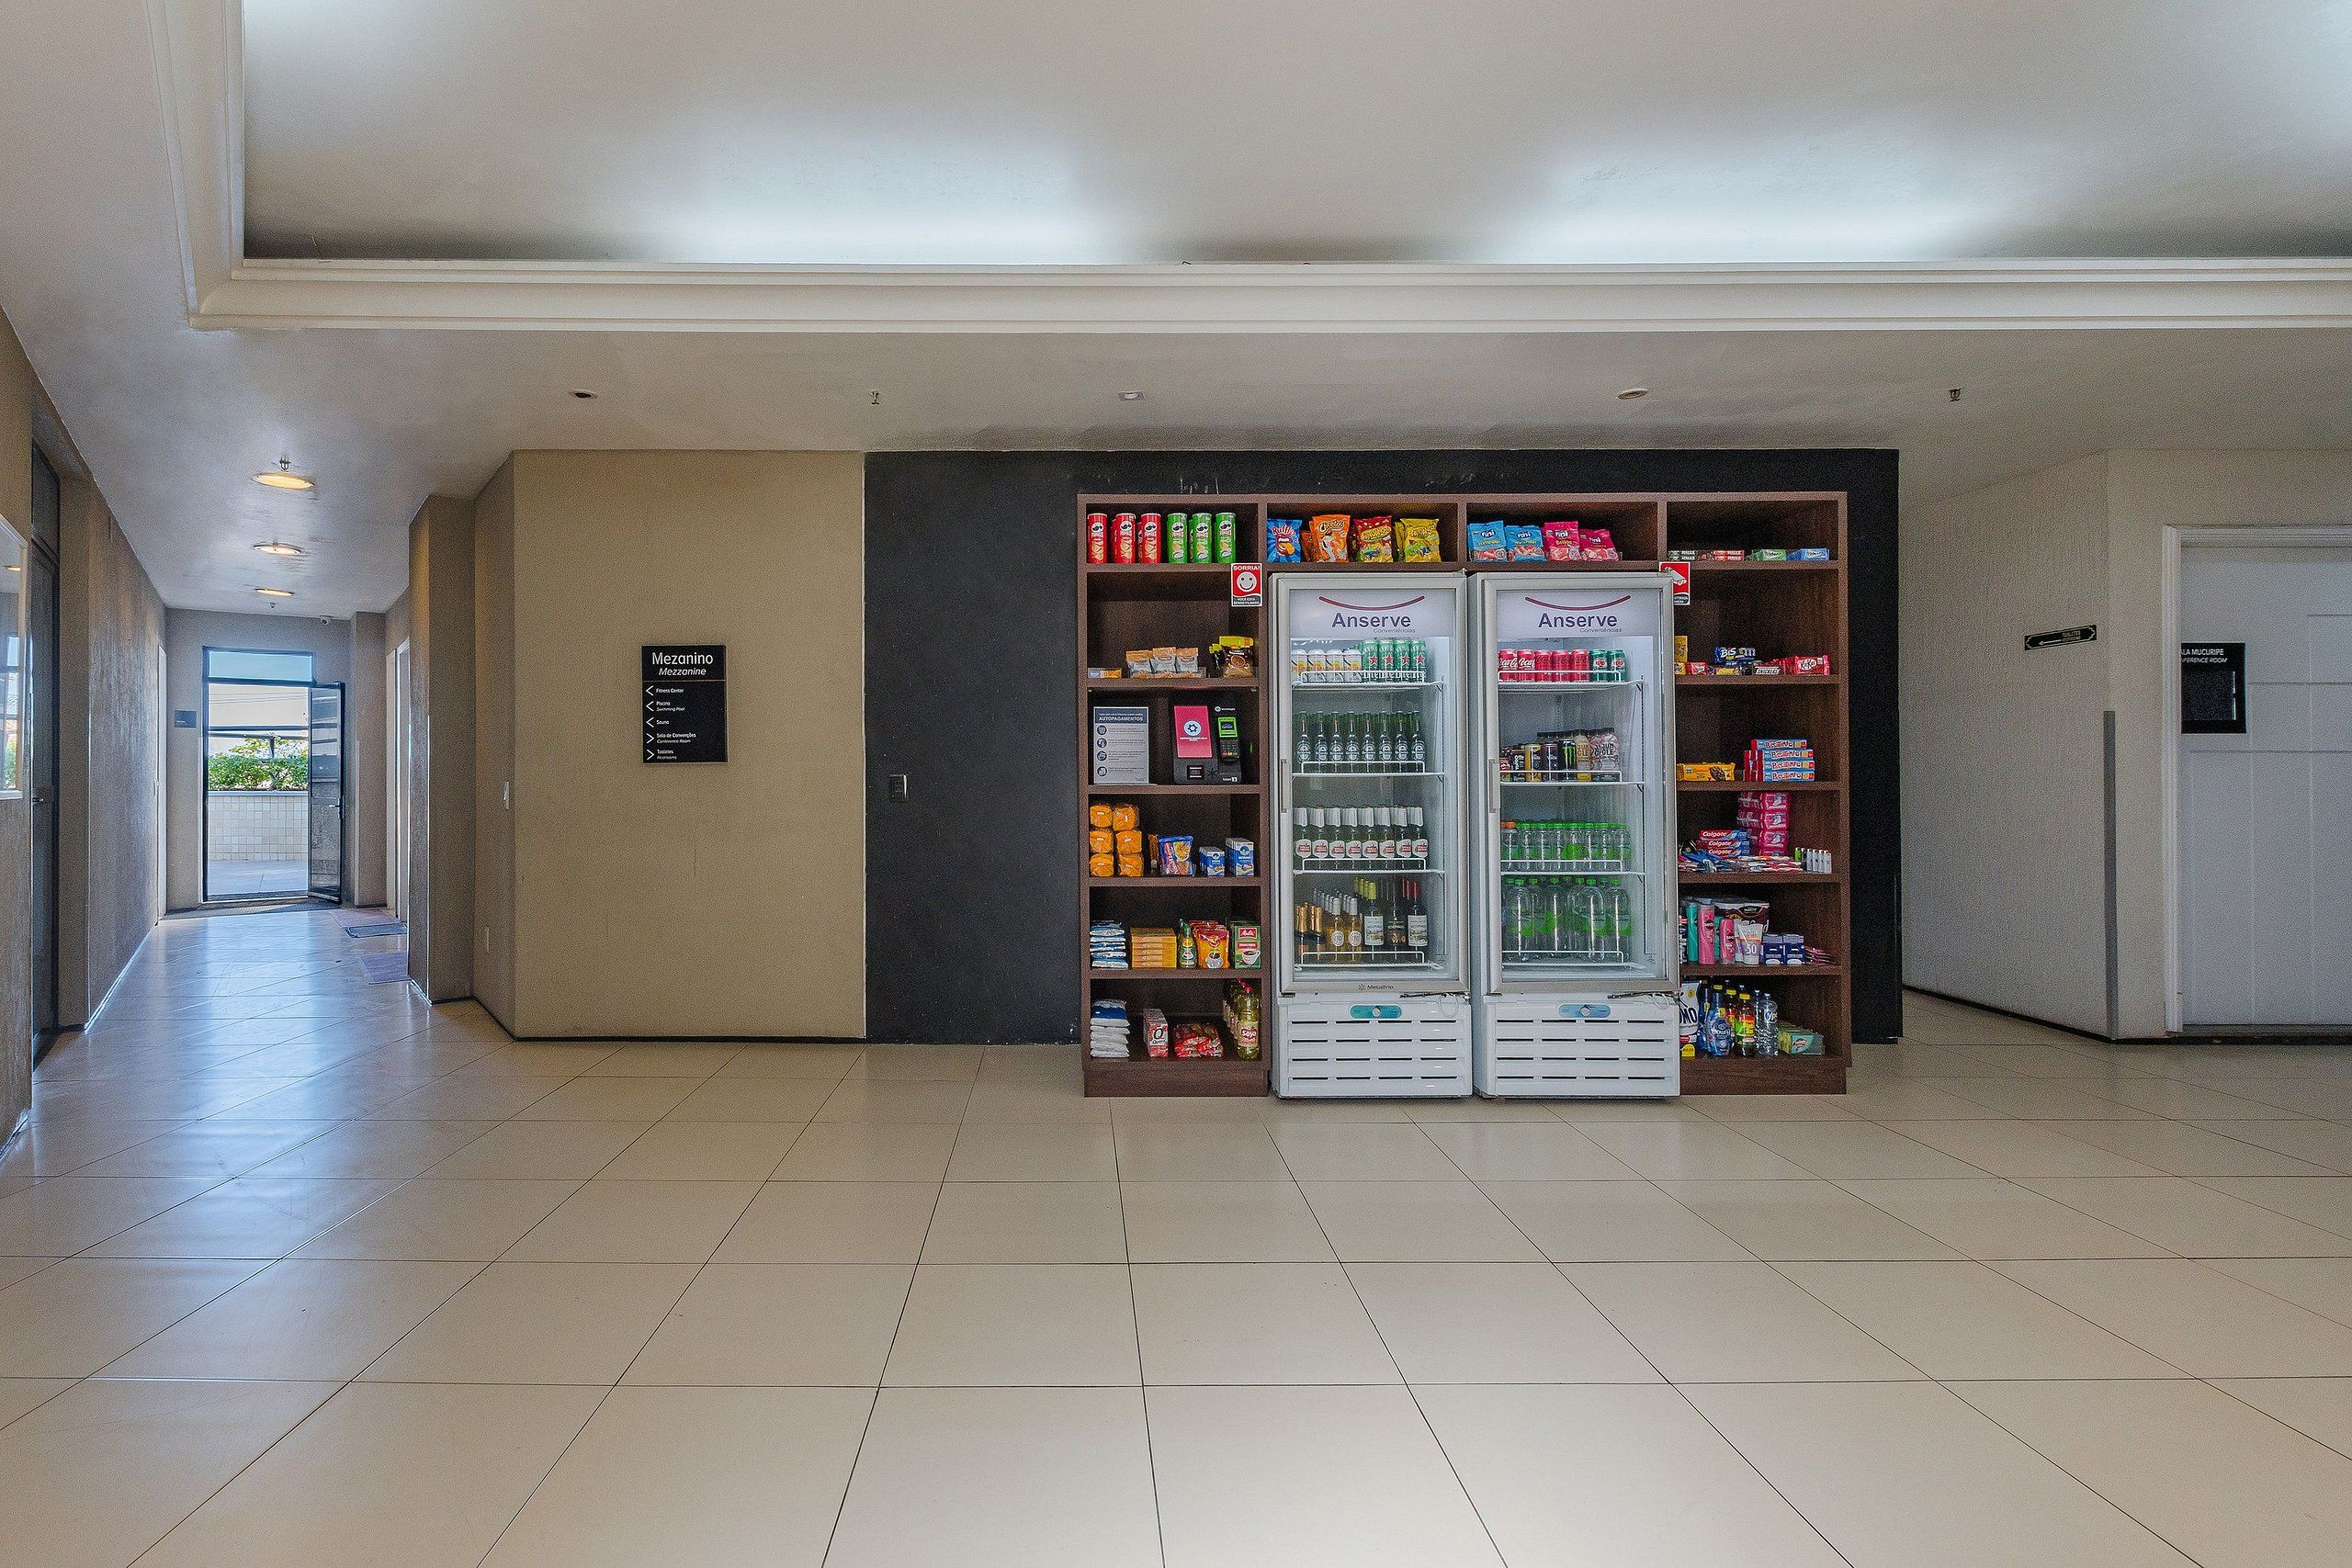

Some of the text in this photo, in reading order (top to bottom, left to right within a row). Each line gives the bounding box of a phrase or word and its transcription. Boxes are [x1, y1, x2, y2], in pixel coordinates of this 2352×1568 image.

[1272, 525, 1295, 536] Ruffles
[1332, 612, 1411, 627] Anserve
[1538, 613, 1618, 628] Anserve
[651, 652, 714, 665] Mezanino
[658, 667, 707, 676] Mezzanine
[1241, 1030, 1257, 1038] Soya
